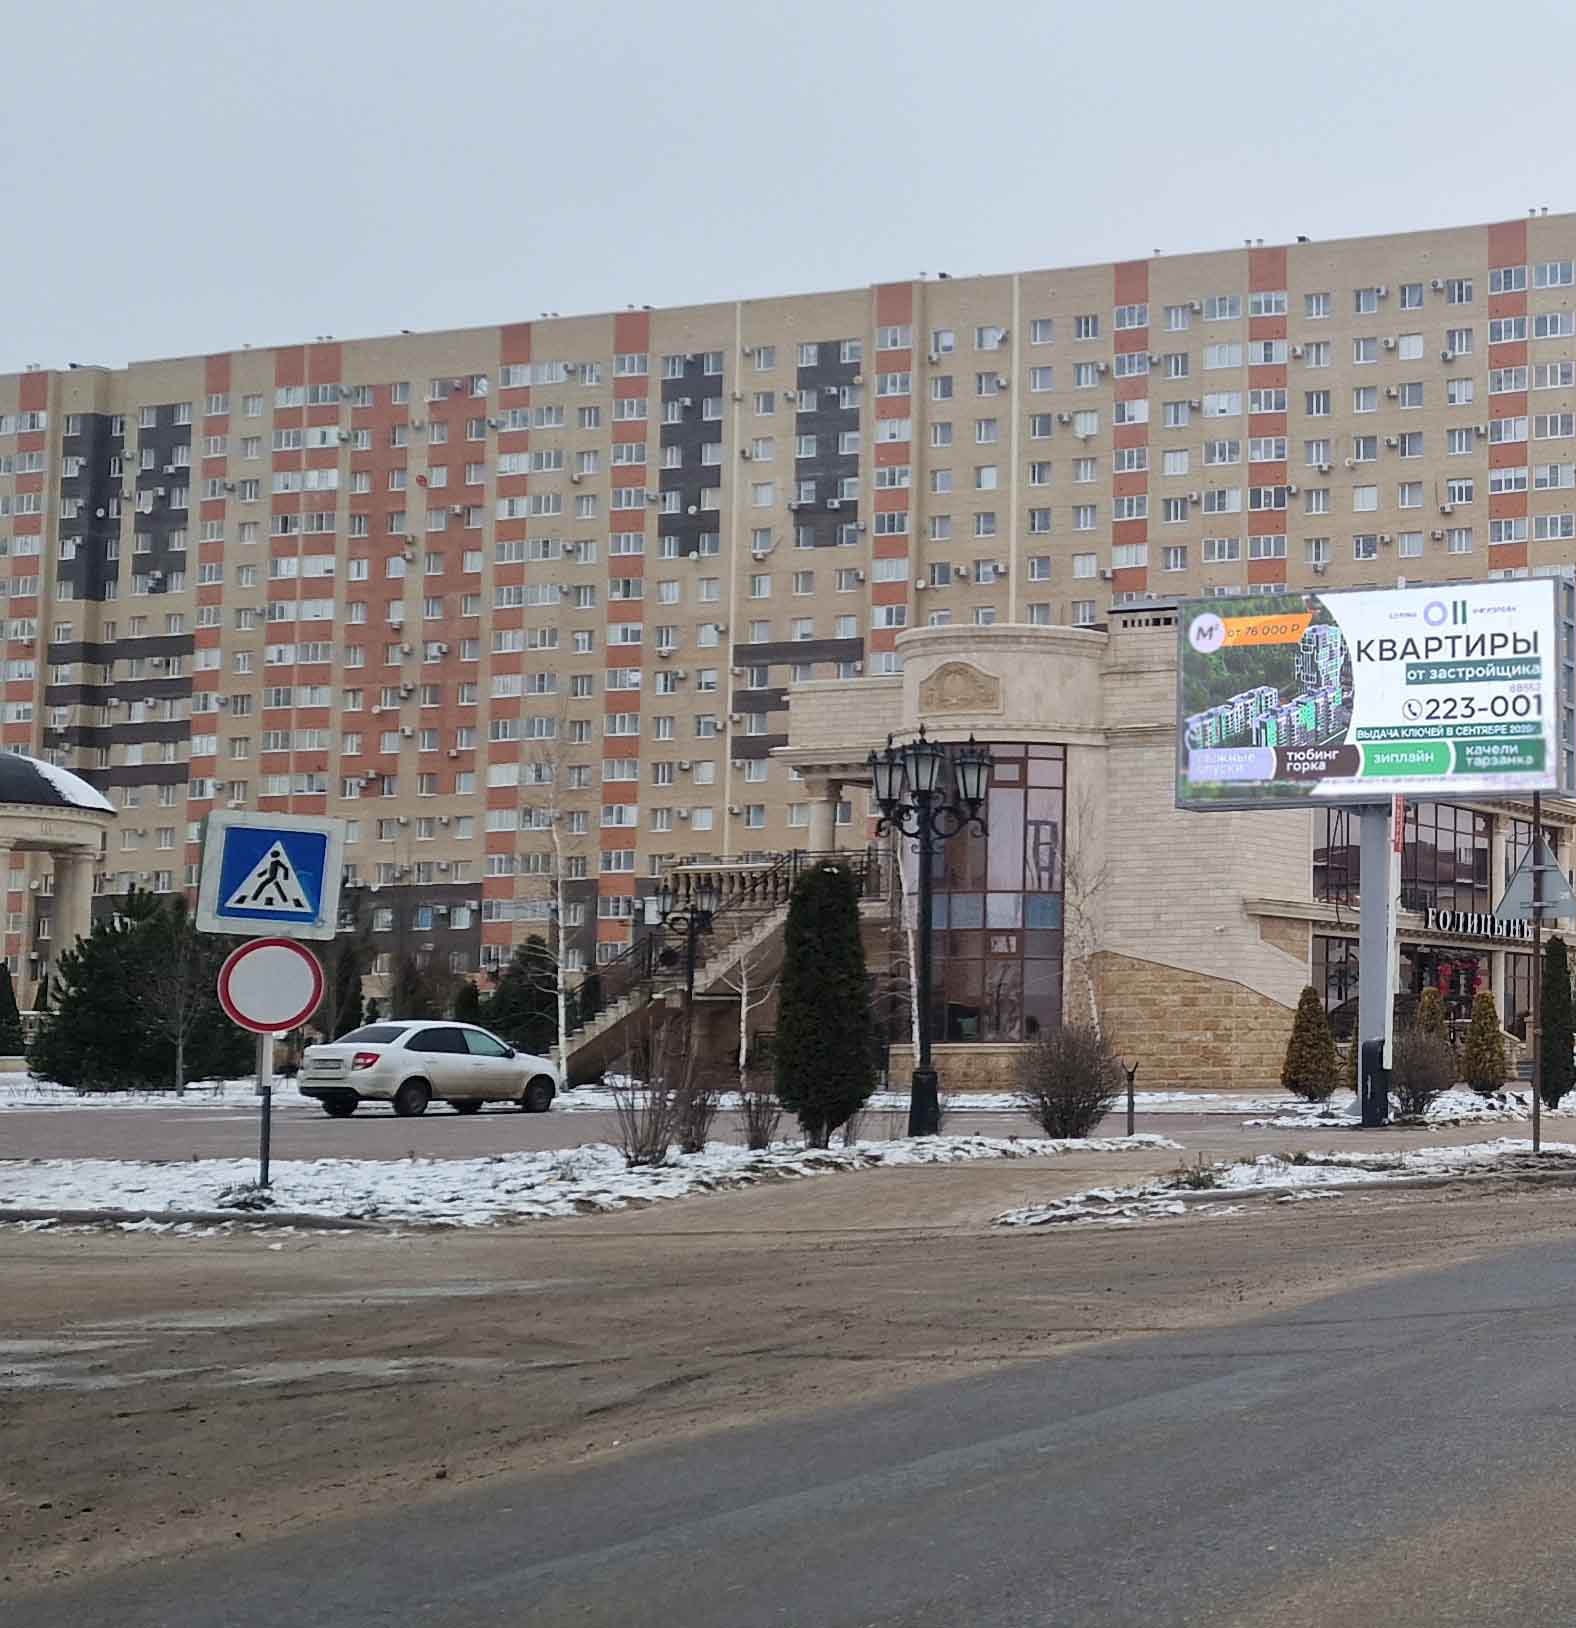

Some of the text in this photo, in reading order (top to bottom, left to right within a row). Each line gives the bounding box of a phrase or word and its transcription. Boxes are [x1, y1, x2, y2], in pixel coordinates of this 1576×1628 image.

[1356, 631, 1538, 662] КВАРТИРЫ
[1407, 663, 1540, 681] от застройщика
[1425, 694, 1542, 720] 223-001
[1357, 729, 1400, 740] ВЫДАЧА
[1401, 726, 1444, 738] КЛЮЧЕЙ
[1455, 724, 1507, 736] СЕНТЯБРЕ
[1286, 749, 1340, 761] тюбинг
[1465, 744, 1519, 755] качели
[1373, 751, 1434, 764] зиплайн
[1465, 756, 1535, 768] тарзанка
[1286, 760, 1326, 773] горка
